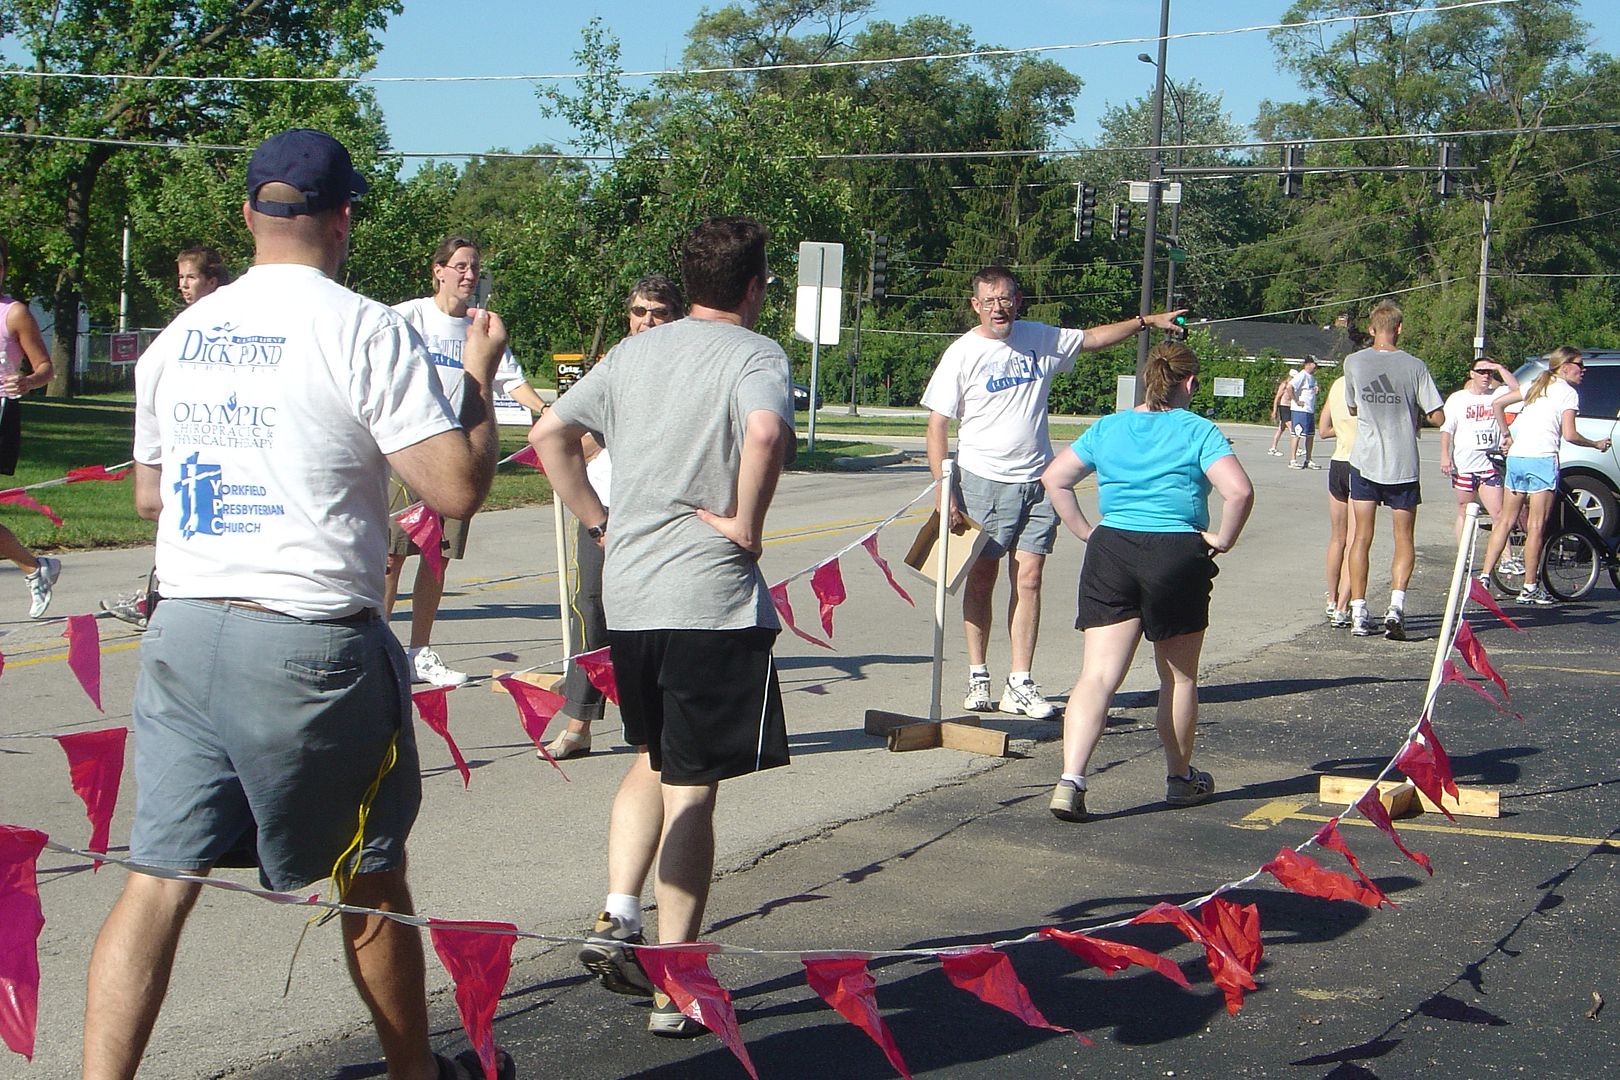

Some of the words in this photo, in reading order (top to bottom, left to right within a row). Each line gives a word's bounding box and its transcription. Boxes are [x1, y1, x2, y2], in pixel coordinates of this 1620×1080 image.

[178, 329, 232, 363] DICK
[1361, 393, 1402, 404] adidas
[173, 402, 277, 427] OLYMPIC
[1476, 432, 1494, 446] 194
[209, 479, 267, 497] YORKFIELD
[212, 498, 286, 516] PRESBYTERIAN
[210, 516, 262, 535] CHURCH
